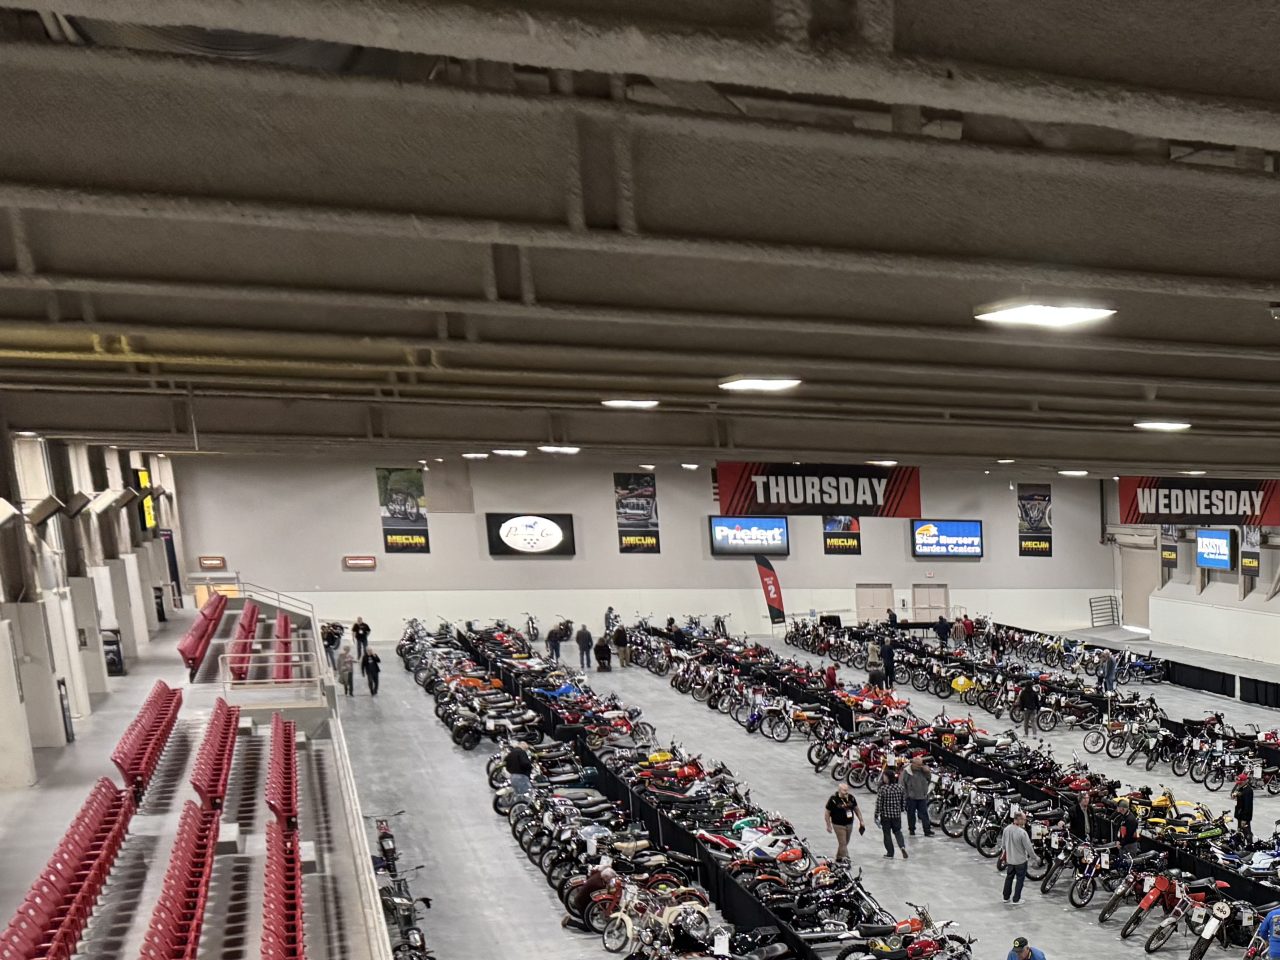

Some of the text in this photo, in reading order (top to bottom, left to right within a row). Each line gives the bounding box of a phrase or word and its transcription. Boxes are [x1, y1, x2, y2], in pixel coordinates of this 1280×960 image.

[751, 475, 887, 506] THURSDAY
[1137, 487, 1265, 516] WEDNESDAY
[715, 525, 783, 541] Priefert
[387, 535, 425, 544] MECUM
[622, 536, 656, 545] MECUM
[826, 538, 857, 546] MECUM
[916, 534, 939, 544] Star
[768, 585, 777, 598] 2
